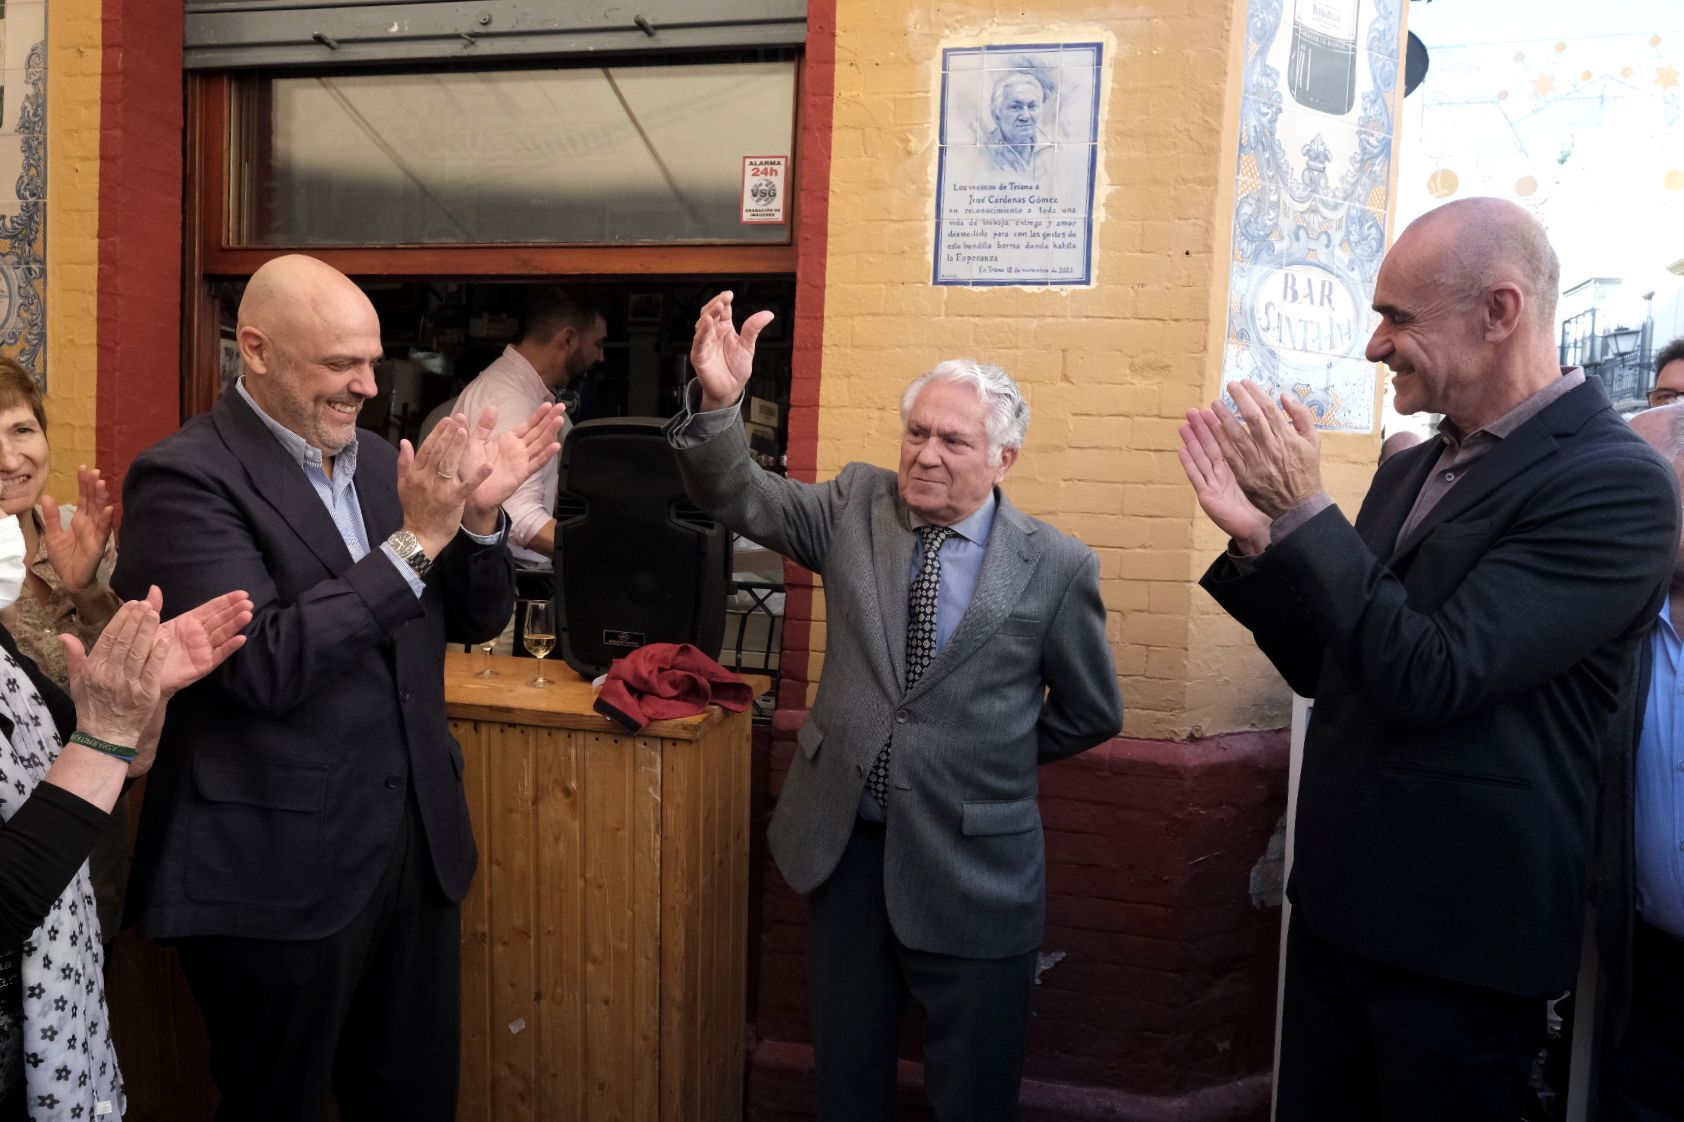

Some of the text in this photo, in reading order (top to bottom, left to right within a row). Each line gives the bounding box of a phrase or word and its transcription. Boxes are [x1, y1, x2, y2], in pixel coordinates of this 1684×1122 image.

[751, 166, 778, 177] 24h
[953, 183, 967, 191] Los
[998, 182, 1007, 191] de
[1008, 182, 1033, 190] Triana
[750, 188, 777, 198] VSG
[968, 194, 987, 205] José
[1028, 195, 1058, 204] Gómez
[1039, 206, 1056, 214] toda
[1046, 220, 1052, 229] y
[947, 229, 988, 237] desmedido
[992, 231, 1009, 239] para
[1030, 229, 1040, 238] las
[1041, 230, 1066, 240] gentes
[963, 241, 992, 249] bendito
[996, 240, 1021, 249] barrio
[1024, 241, 1049, 249] donde
[1053, 241, 1077, 249] habita
[946, 252, 998, 264] la Esperanza
[978, 265, 987, 273] En
[988, 265, 1005, 273] Triana
[1058, 266, 1074, 274] 2022
[1282, 271, 1336, 312] BAR
